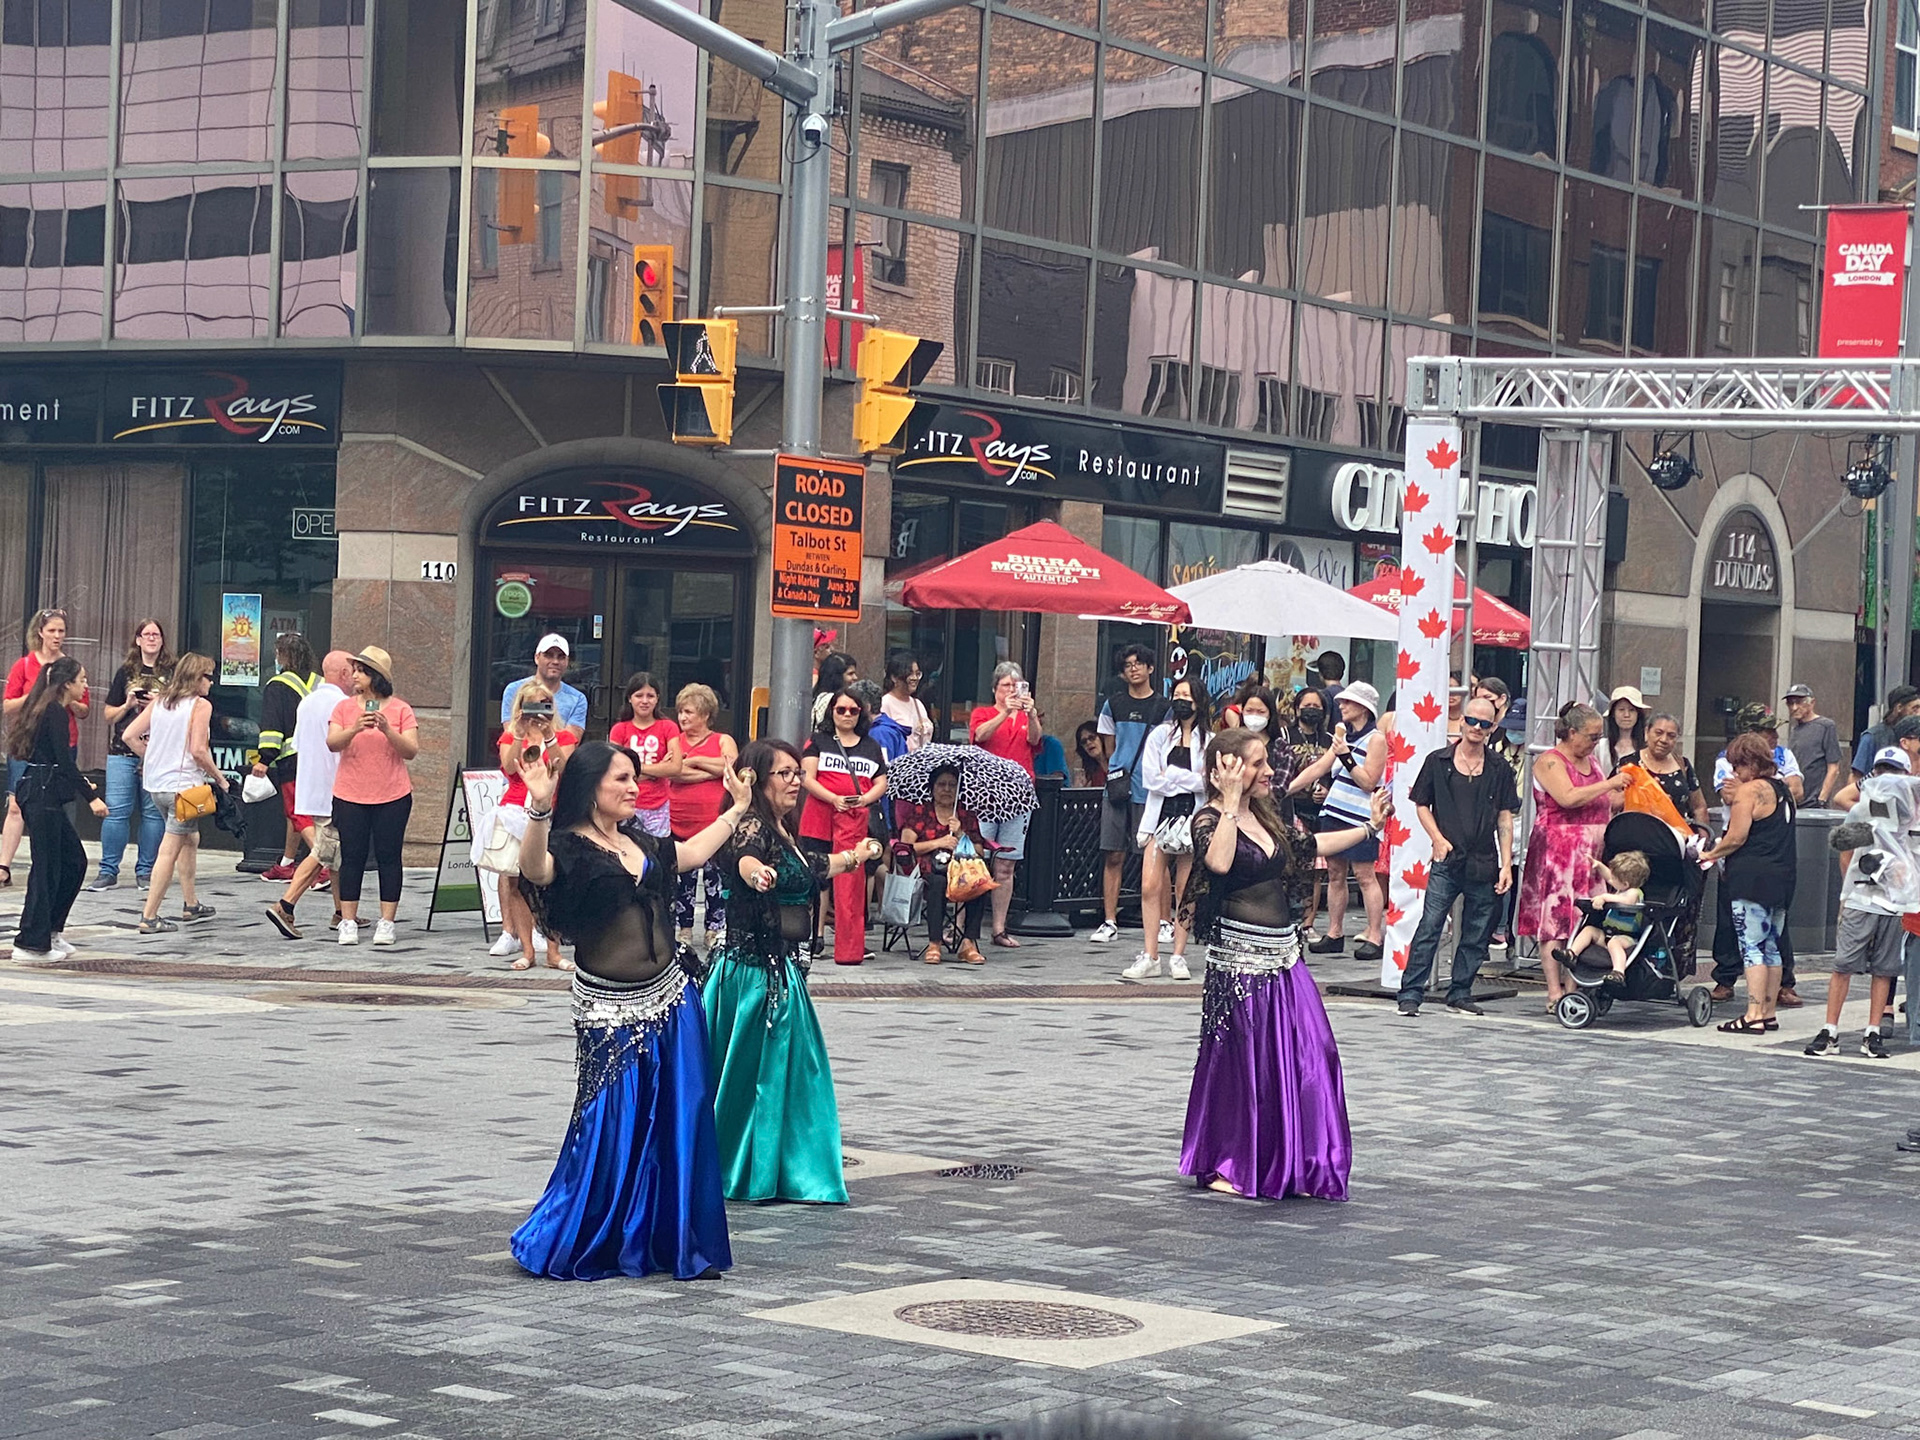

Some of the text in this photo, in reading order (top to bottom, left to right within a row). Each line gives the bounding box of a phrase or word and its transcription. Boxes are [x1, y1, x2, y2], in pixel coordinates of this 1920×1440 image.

[1838, 243, 1894, 256] CANADA
[1845, 254, 1887, 272] DAY
[1837, 338, 1884, 347] presented by
[132, 397, 194, 418] FITZ
[1079, 449, 1200, 486] Restaurant
[795, 474, 846, 498] ROAD
[519, 496, 591, 515] FITZ
[785, 501, 853, 526] CLOSED
[581, 532, 655, 544] Restaurant
[790, 531, 847, 552] Talbot St
[1729, 533, 1756, 561] 114
[805, 553, 830, 561] BETWEEN
[1007, 554, 1083, 568] BIRRA
[422, 562, 456, 580] 110
[786, 560, 847, 578] Dundas & Carling
[990, 561, 1100, 578] MORETTI
[1014, 572, 1079, 583] L'AUTENTICA
[1714, 560, 1774, 591] DUNDAS
[779, 572, 797, 586] Night
[798, 575, 819, 587] Market
[827, 580, 843, 592] June
[777, 587, 852, 608] & Canada Day July 2
[270, 618, 298, 630] ATM
[209, 747, 242, 770] TM
